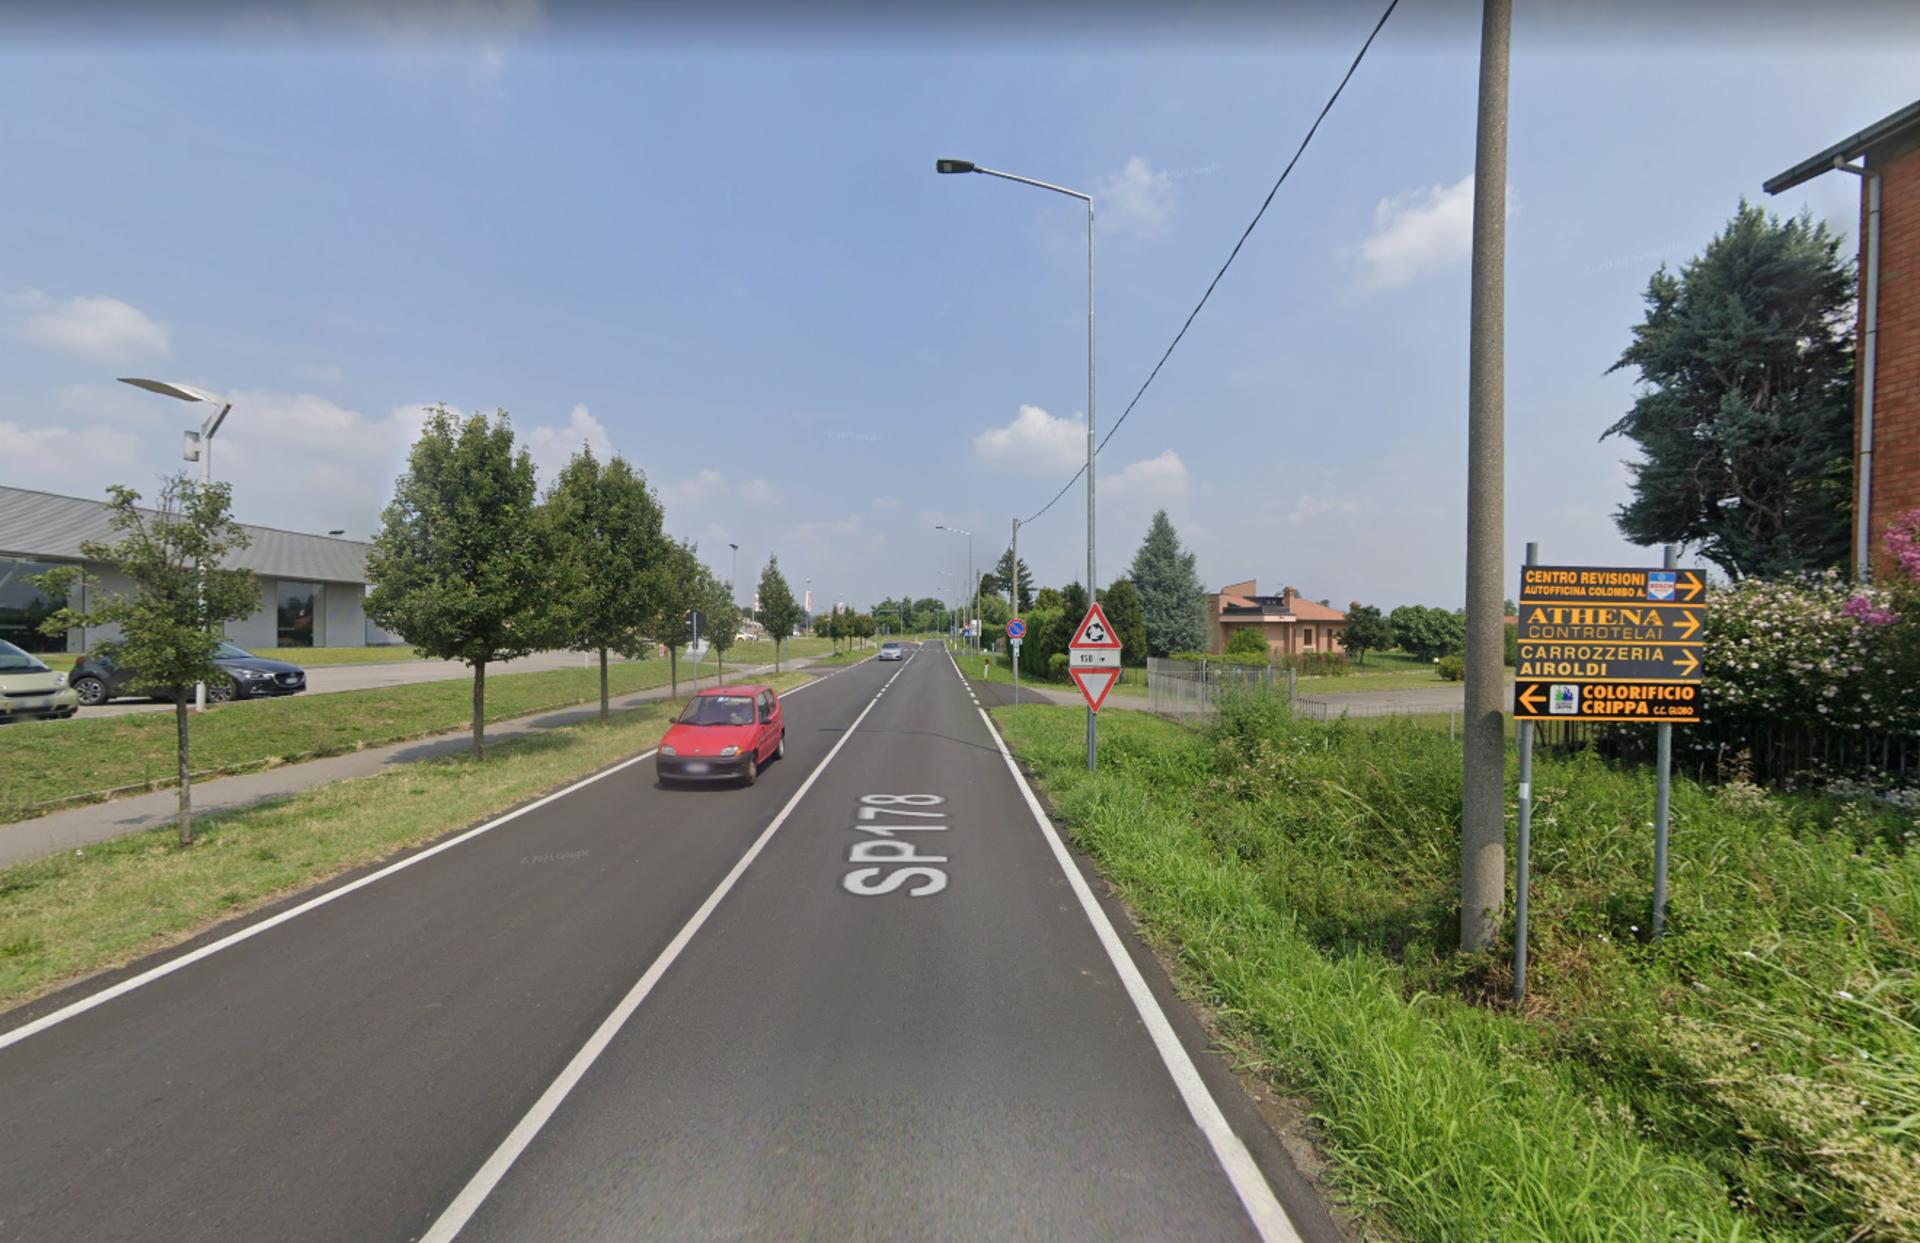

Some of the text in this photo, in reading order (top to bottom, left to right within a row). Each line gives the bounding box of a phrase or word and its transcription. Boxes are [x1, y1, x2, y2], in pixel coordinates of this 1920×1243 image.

[1526, 570, 1645, 586] CENTRO REVISIONI
[1524, 585, 1586, 596] AUTOFFICINA
[1588, 586, 1635, 597] COLOMBO
[1527, 607, 1664, 626] ATHENA
[1529, 625, 1662, 640] CONTROTELAI
[1521, 645, 1665, 661] CARROZZERIA
[1520, 662, 1607, 676] AIROLDI
[1583, 685, 1694, 700] COLORIFICIO
[1582, 700, 1649, 714] CRIPPA
[843, 794, 948, 897] SP178
